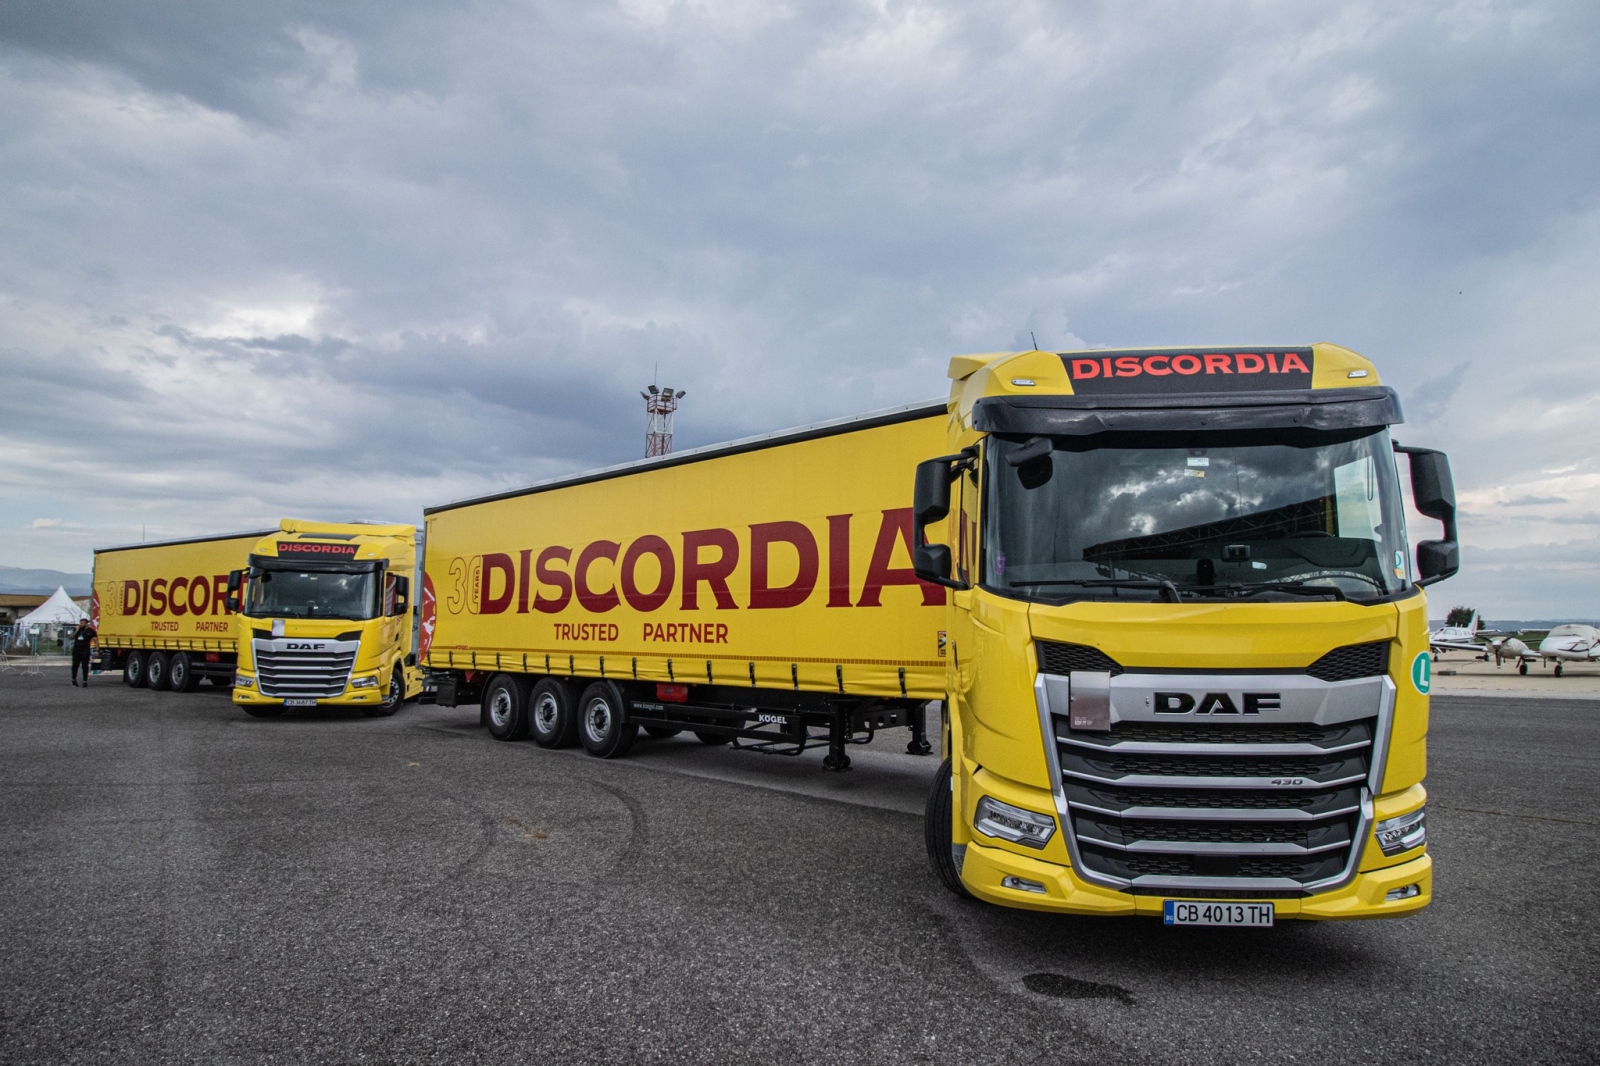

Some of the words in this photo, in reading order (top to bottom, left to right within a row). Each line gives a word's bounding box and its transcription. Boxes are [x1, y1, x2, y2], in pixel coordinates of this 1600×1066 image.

[1071, 353, 1311, 379] DISCORDIA
[278, 543, 356, 554] DISCORDIA
[479, 507, 947, 615] DISCORDIA
[122, 574, 249, 616] DISCOR
[151, 621, 179, 632] TRUSTED
[195, 621, 229, 632] PARTNER
[553, 622, 619, 642] TRUSTED
[642, 622, 729, 644] PARTNER
[1419, 658, 1429, 687] L
[1153, 691, 1281, 716] DAF
[758, 713, 788, 725] KÖGEL
[1271, 778, 1304, 786] 430
[1176, 904, 1199, 922] CB
[1202, 905, 1244, 923] 4013
[1248, 906, 1270, 924] TH
